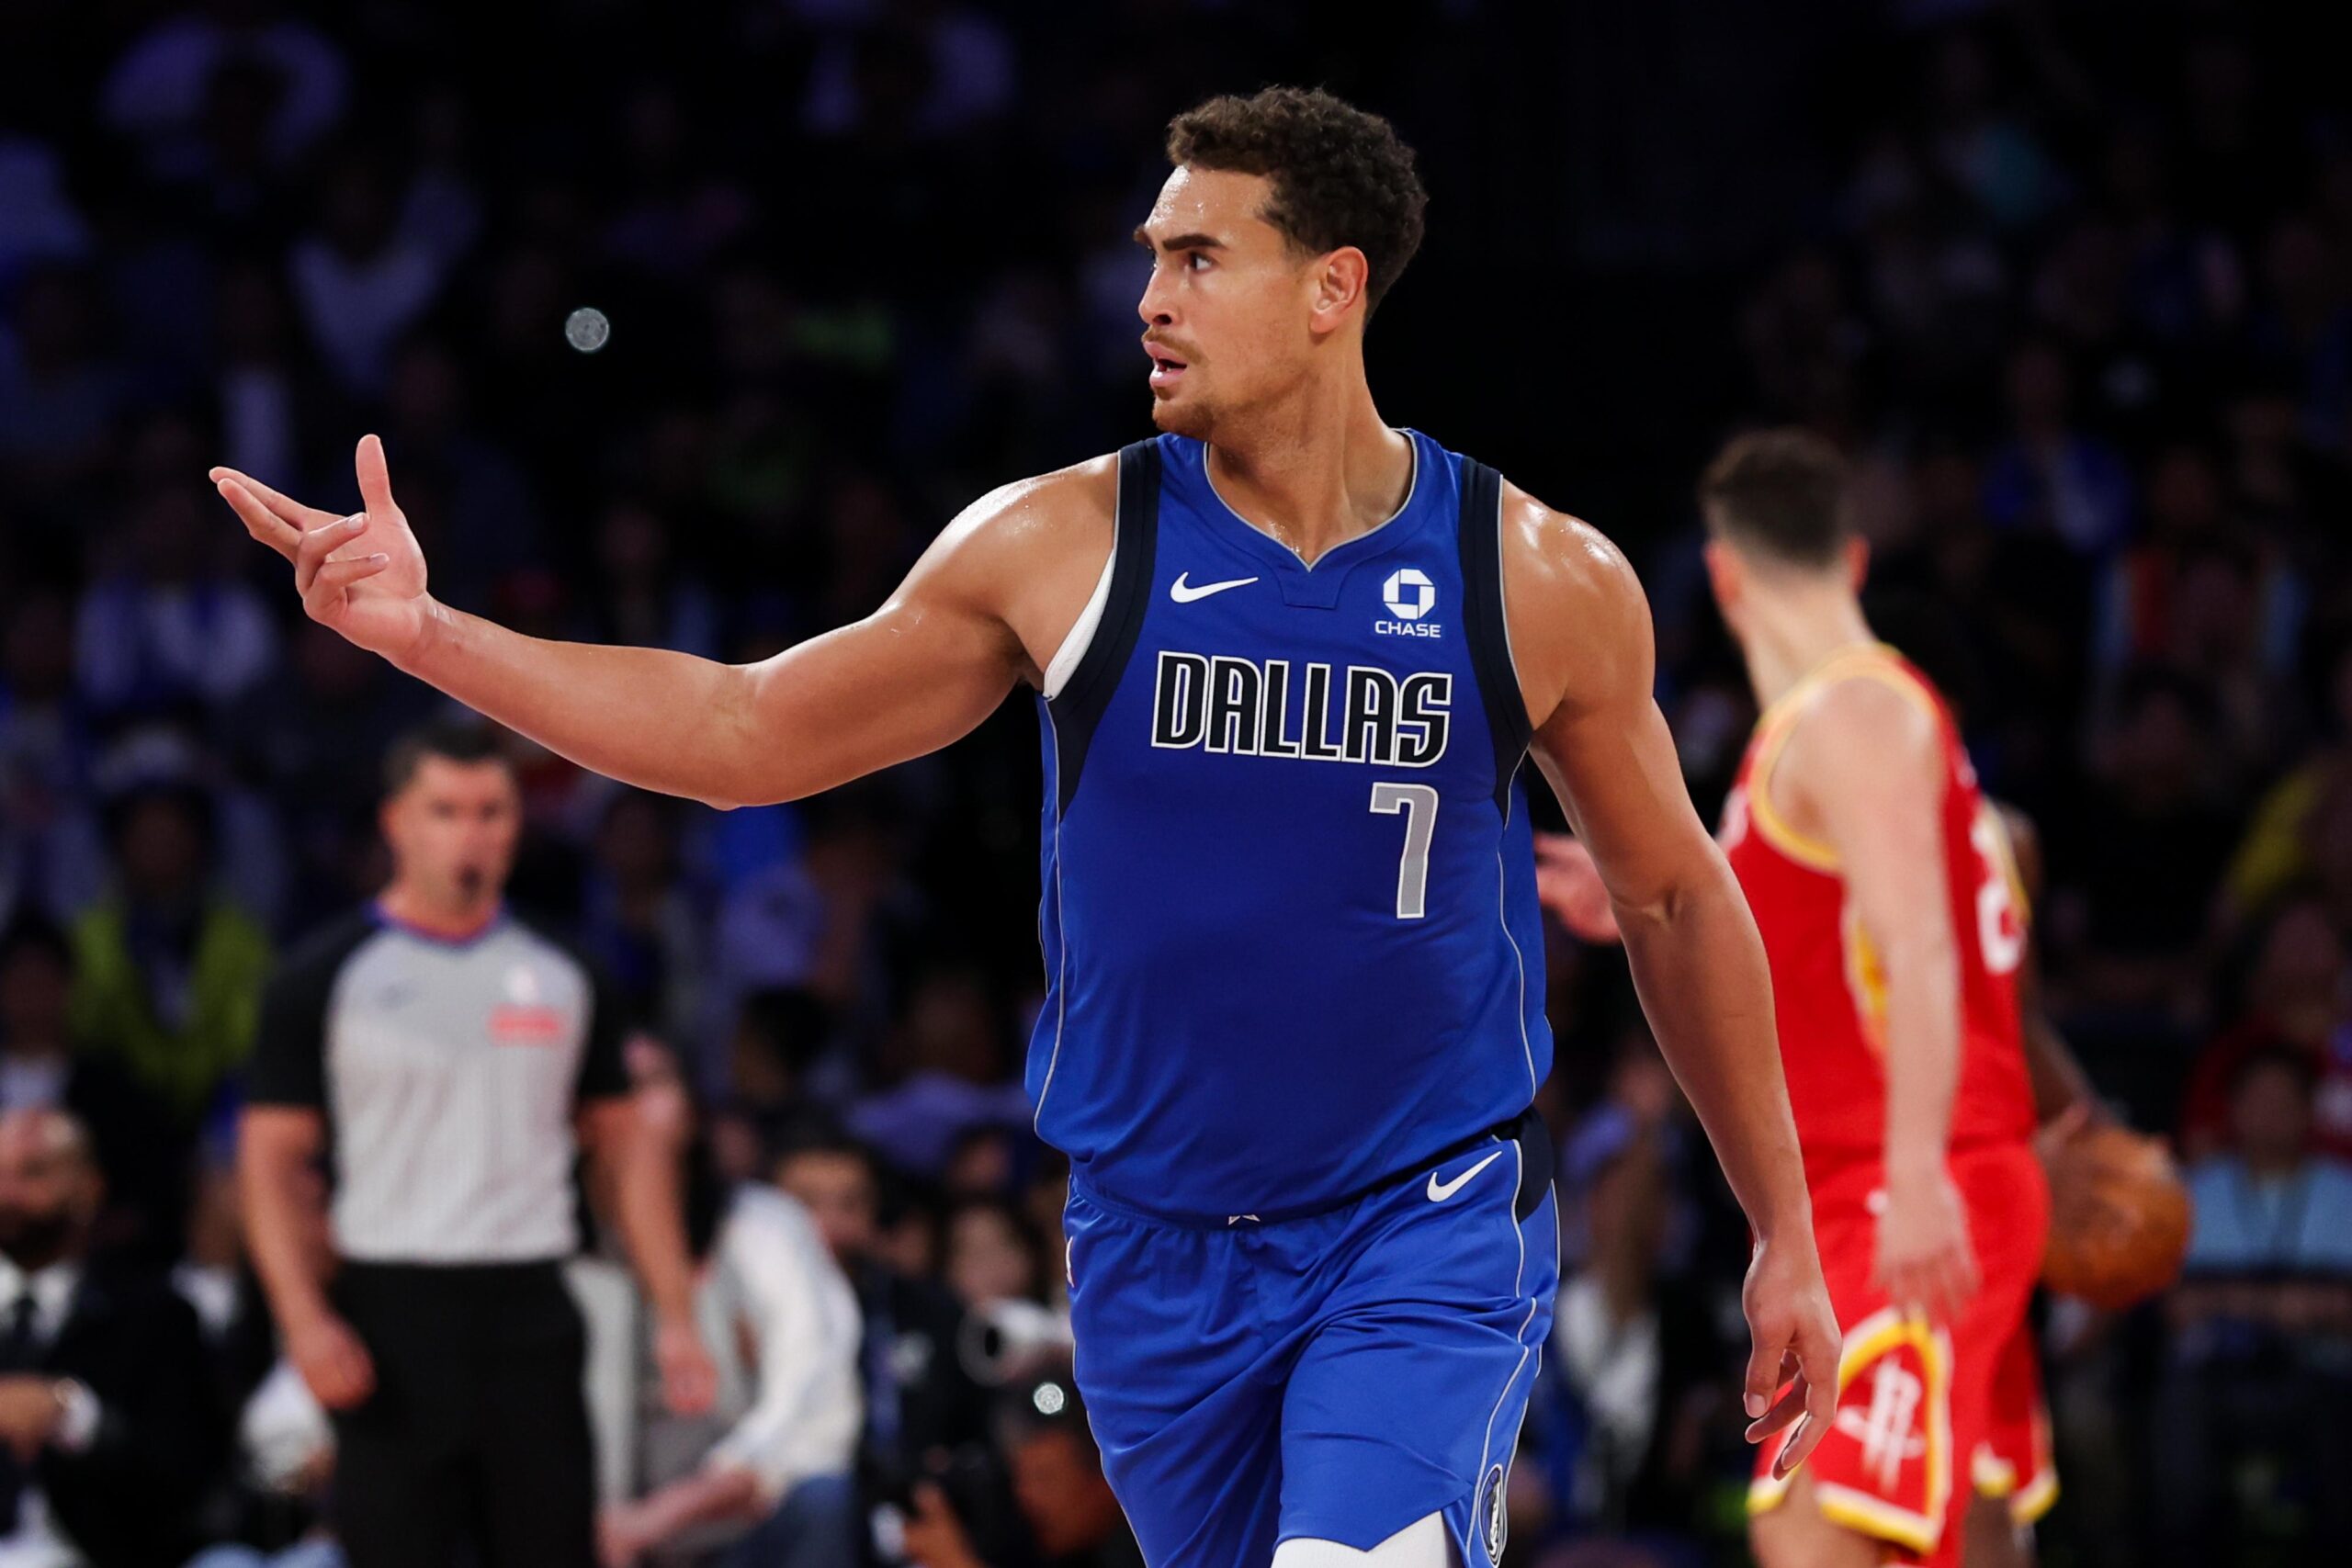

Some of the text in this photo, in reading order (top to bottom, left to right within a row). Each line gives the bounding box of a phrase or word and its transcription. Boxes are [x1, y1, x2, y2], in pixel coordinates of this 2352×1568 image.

[1374, 620, 1442, 638] CHASE
[1151, 650, 1453, 768] DALLAS
[1369, 782, 1439, 919] 7
